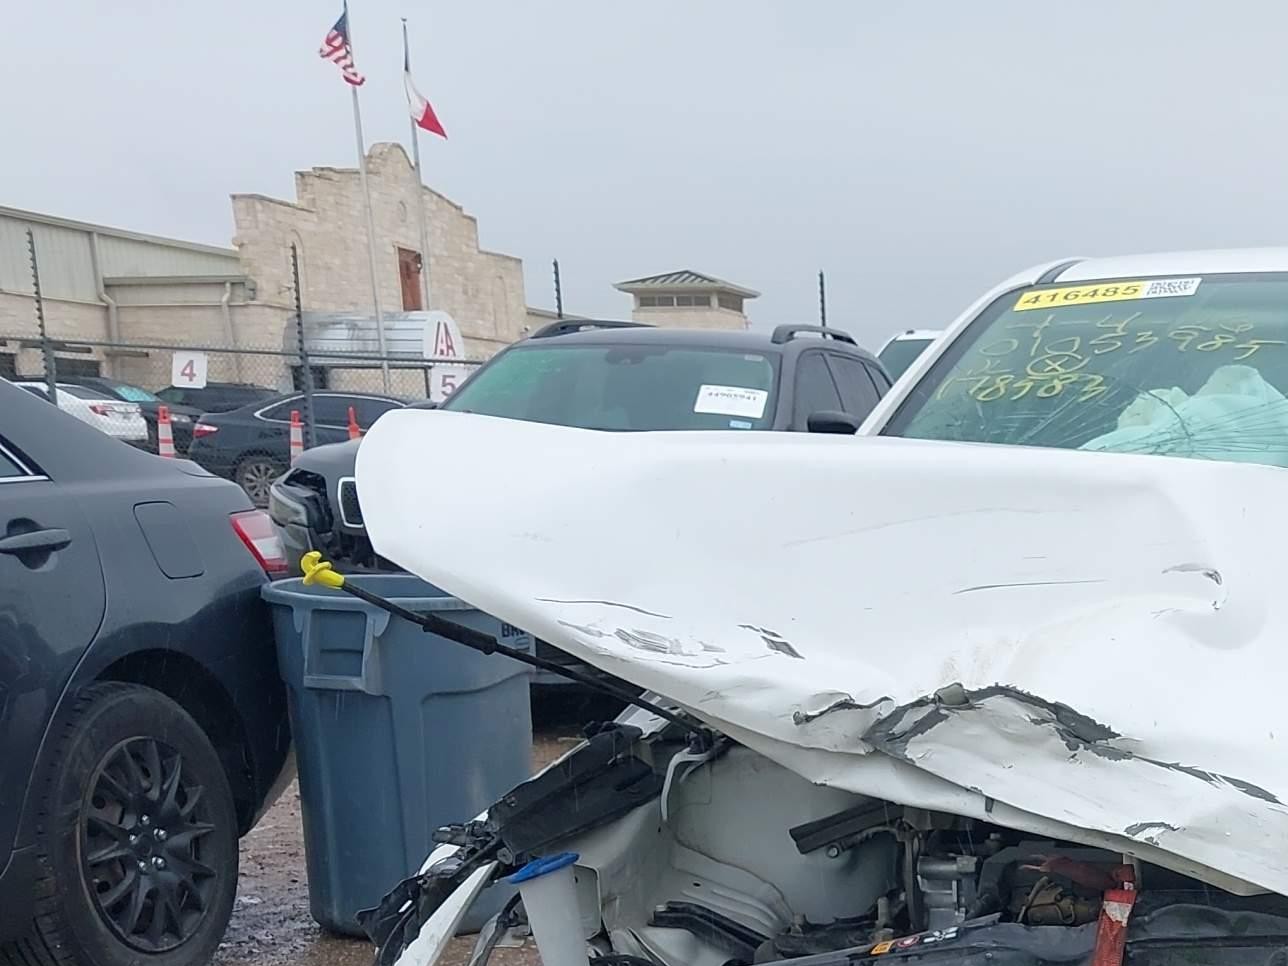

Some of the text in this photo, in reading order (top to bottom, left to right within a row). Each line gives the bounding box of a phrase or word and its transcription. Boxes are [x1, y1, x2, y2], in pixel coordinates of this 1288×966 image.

[1023, 284, 1141, 305] 416485
[180, 359, 197, 382] 4
[440, 374, 457, 397] 5
